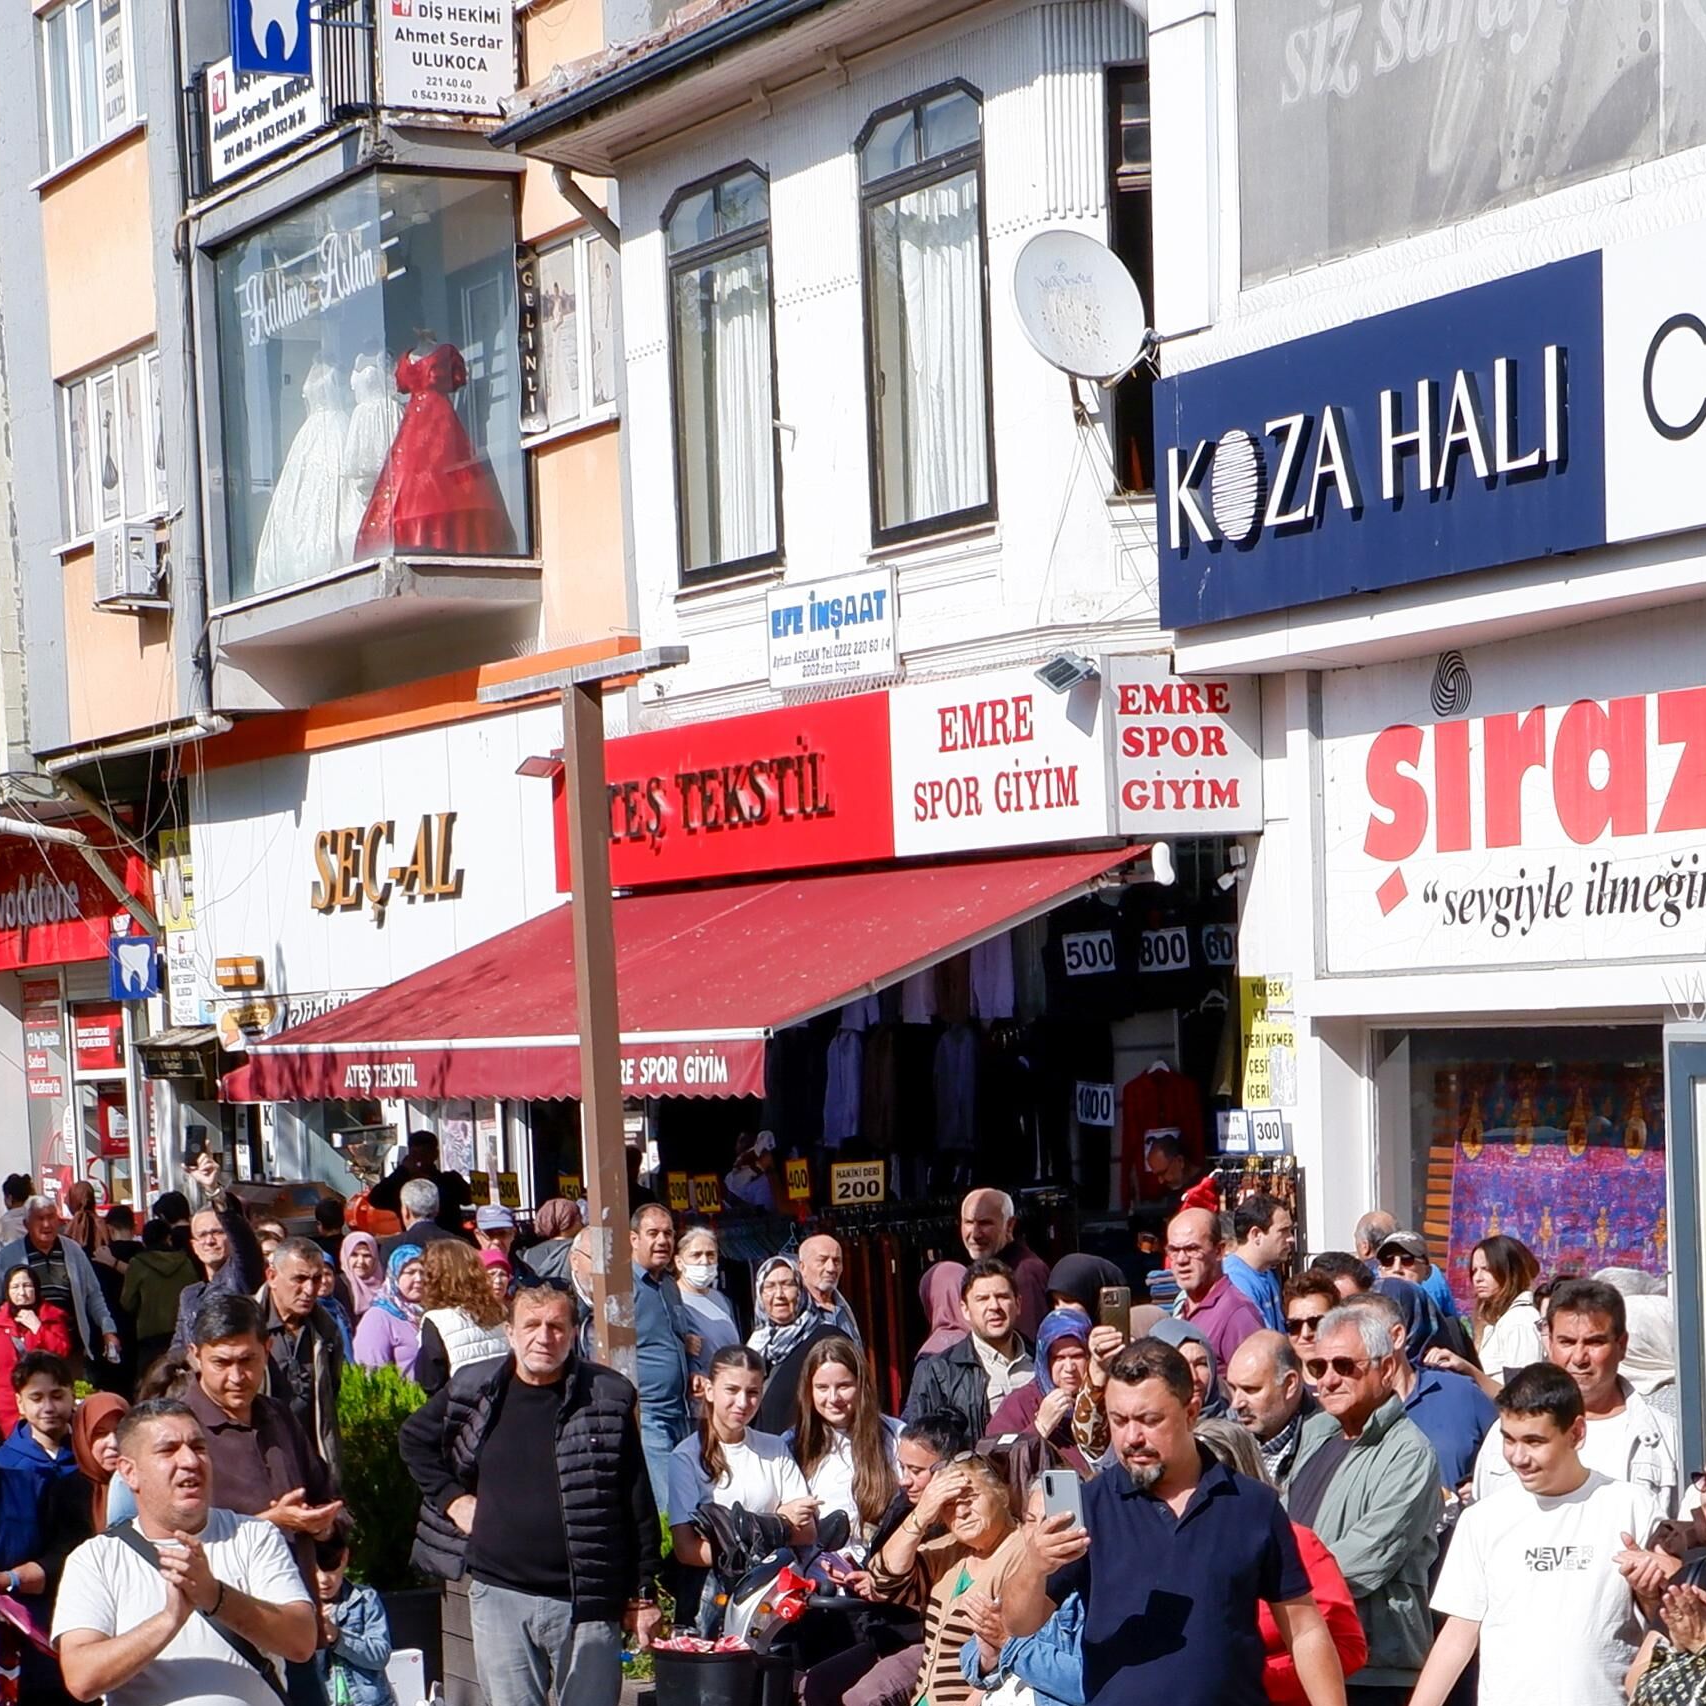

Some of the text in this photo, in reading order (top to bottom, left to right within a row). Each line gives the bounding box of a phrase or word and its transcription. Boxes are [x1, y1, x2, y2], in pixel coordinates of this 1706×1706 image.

[419, 1, 501, 24] DİŞ HEKİMİ
[395, 27, 503, 50] Ahmet Serdar
[412, 52, 488, 72] ULUKOCA
[412, 90, 487, 105] 0 543 933 26 26
[426, 76, 472, 89] 221 40 40
[1168, 345, 1561, 549] KOZA HALI
[772, 589, 887, 640] EFE İNŞAAT
[1118, 683, 1231, 715] EMRE
[938, 695, 1034, 753] EMRE
[1122, 727, 1228, 757] SPOR
[608, 735, 834, 854] TEŞ TEKSTİL
[914, 756, 1079, 823] SPOR GİYİM
[1122, 769, 1240, 811] GİYİM
[311, 812, 461, 927] SEÇ-AL
[1066, 937, 1114, 970] 500
[1142, 932, 1187, 967] 800
[1251, 979, 1285, 998] YÜKSEK
[1244, 1033, 1294, 1049] DERİ KEMER
[345, 1057, 418, 1094] ATEŞ TEKSTİL
[620, 1049, 728, 1086] RE SPOR GİYİM
[1078, 1086, 1111, 1121] 1000
[1256, 1121, 1280, 1141] 300
[696, 1181, 719, 1206] 300
[838, 1180, 880, 1199] 200
